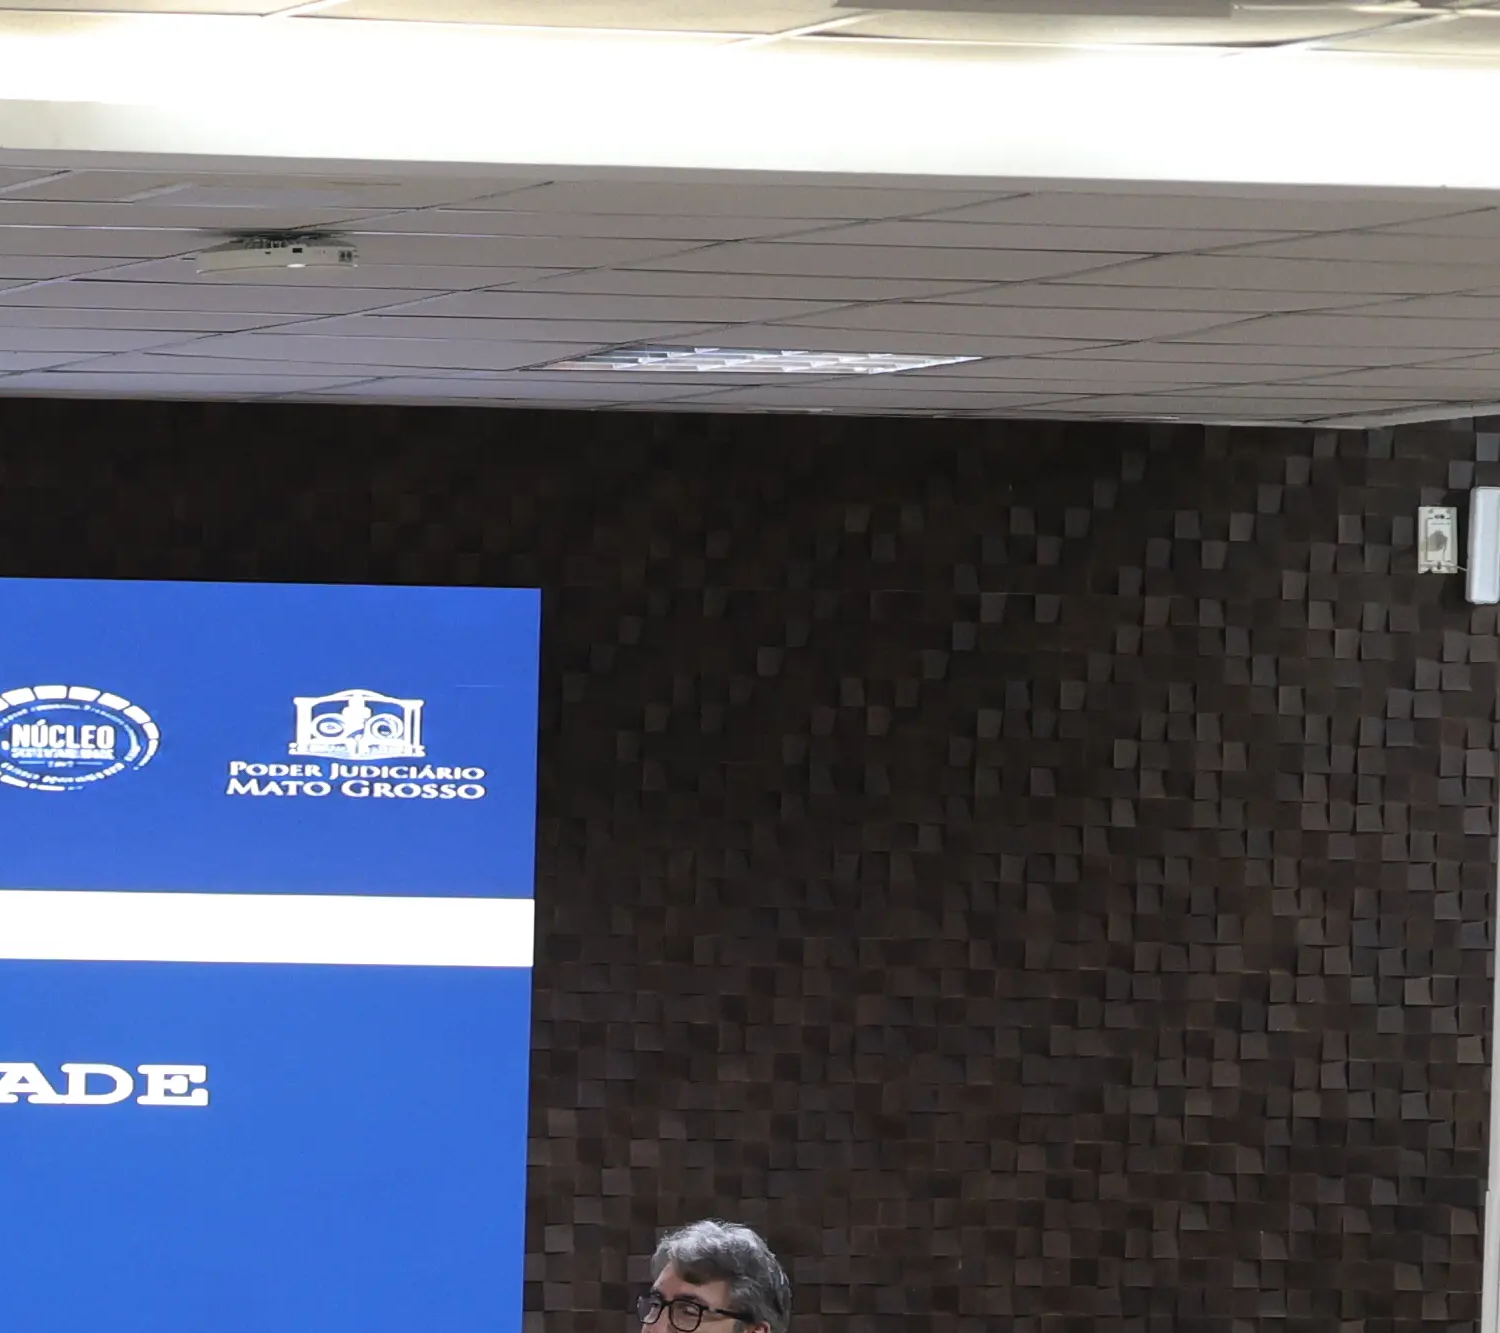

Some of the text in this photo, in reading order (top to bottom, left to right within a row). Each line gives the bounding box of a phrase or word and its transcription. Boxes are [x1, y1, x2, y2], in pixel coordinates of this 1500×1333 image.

[11, 719, 115, 749] NÚCLEO
[229, 760, 485, 780] PODER JUDICIÁRIO
[227, 778, 486, 799] MATO GROSSO
